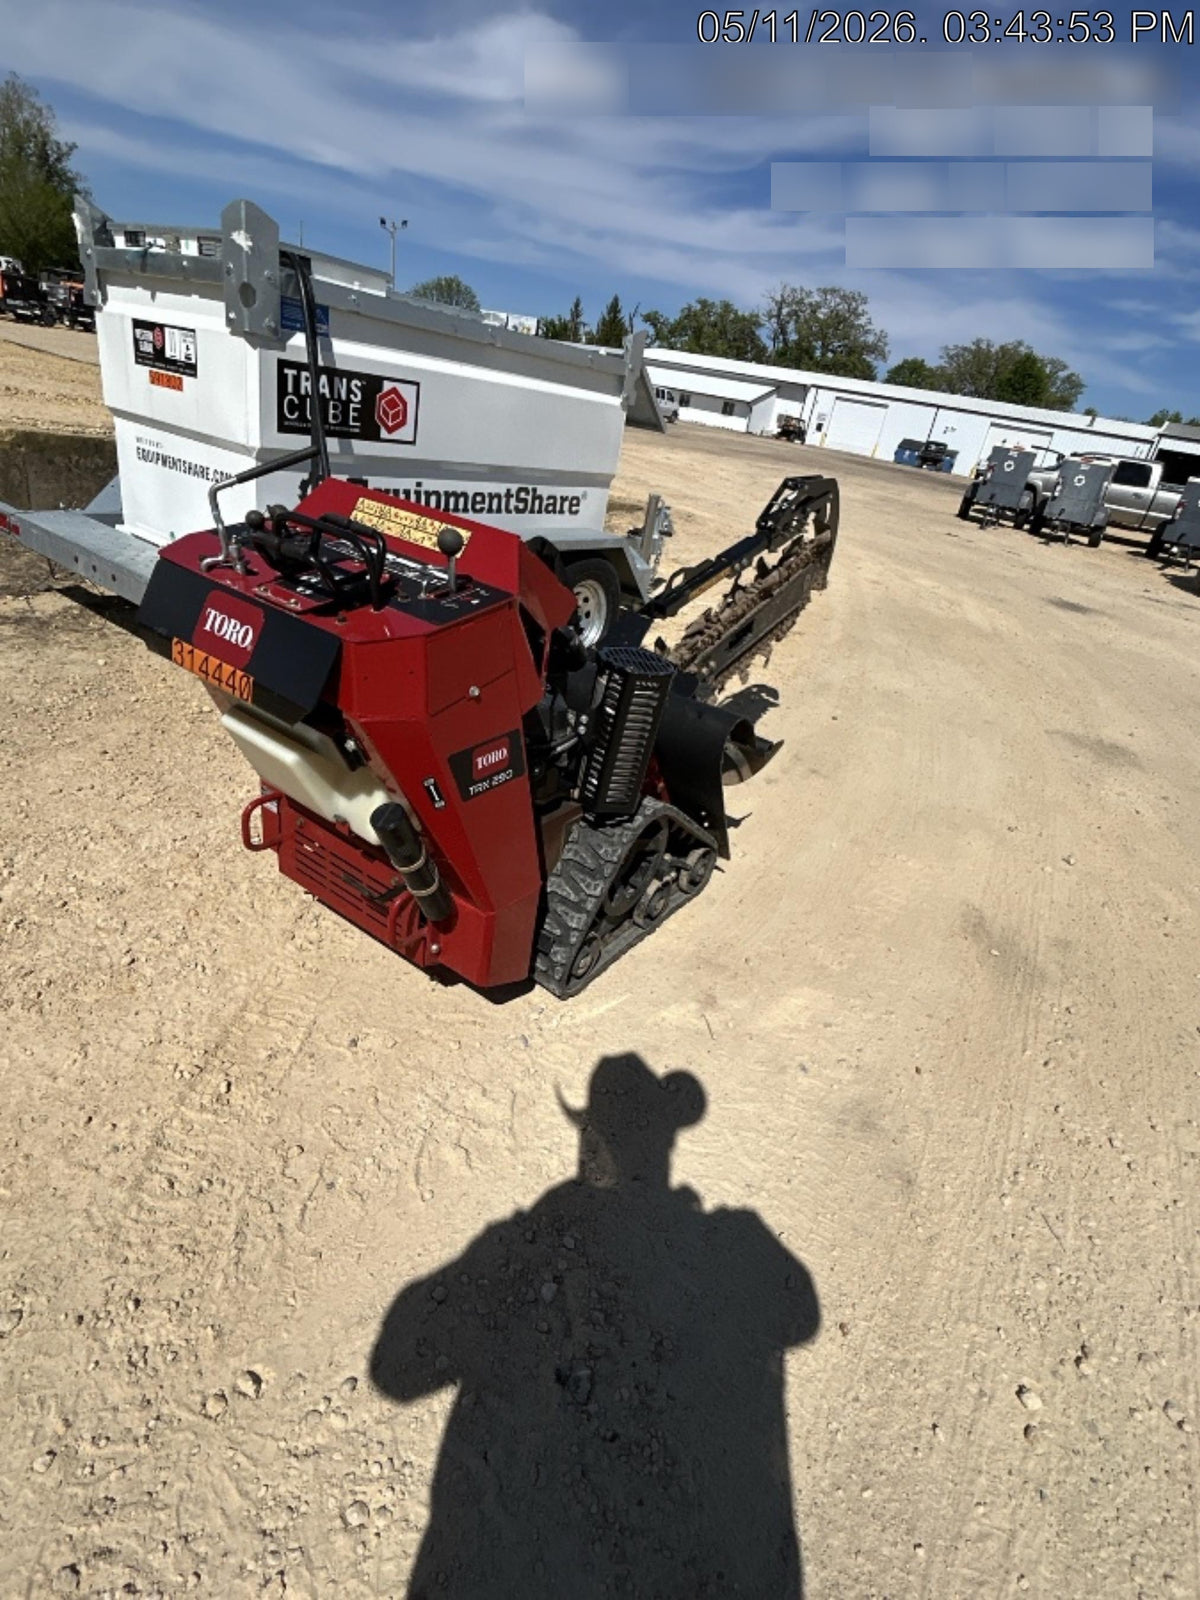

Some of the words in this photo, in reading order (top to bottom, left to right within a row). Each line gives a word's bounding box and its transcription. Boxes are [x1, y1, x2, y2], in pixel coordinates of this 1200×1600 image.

[283, 367, 362, 402] TRANS
[346, 478, 581, 516] ipmentShare
[203, 607, 254, 648] TORO
[173, 640, 252, 701] 314440
[475, 747, 508, 770] TORO
